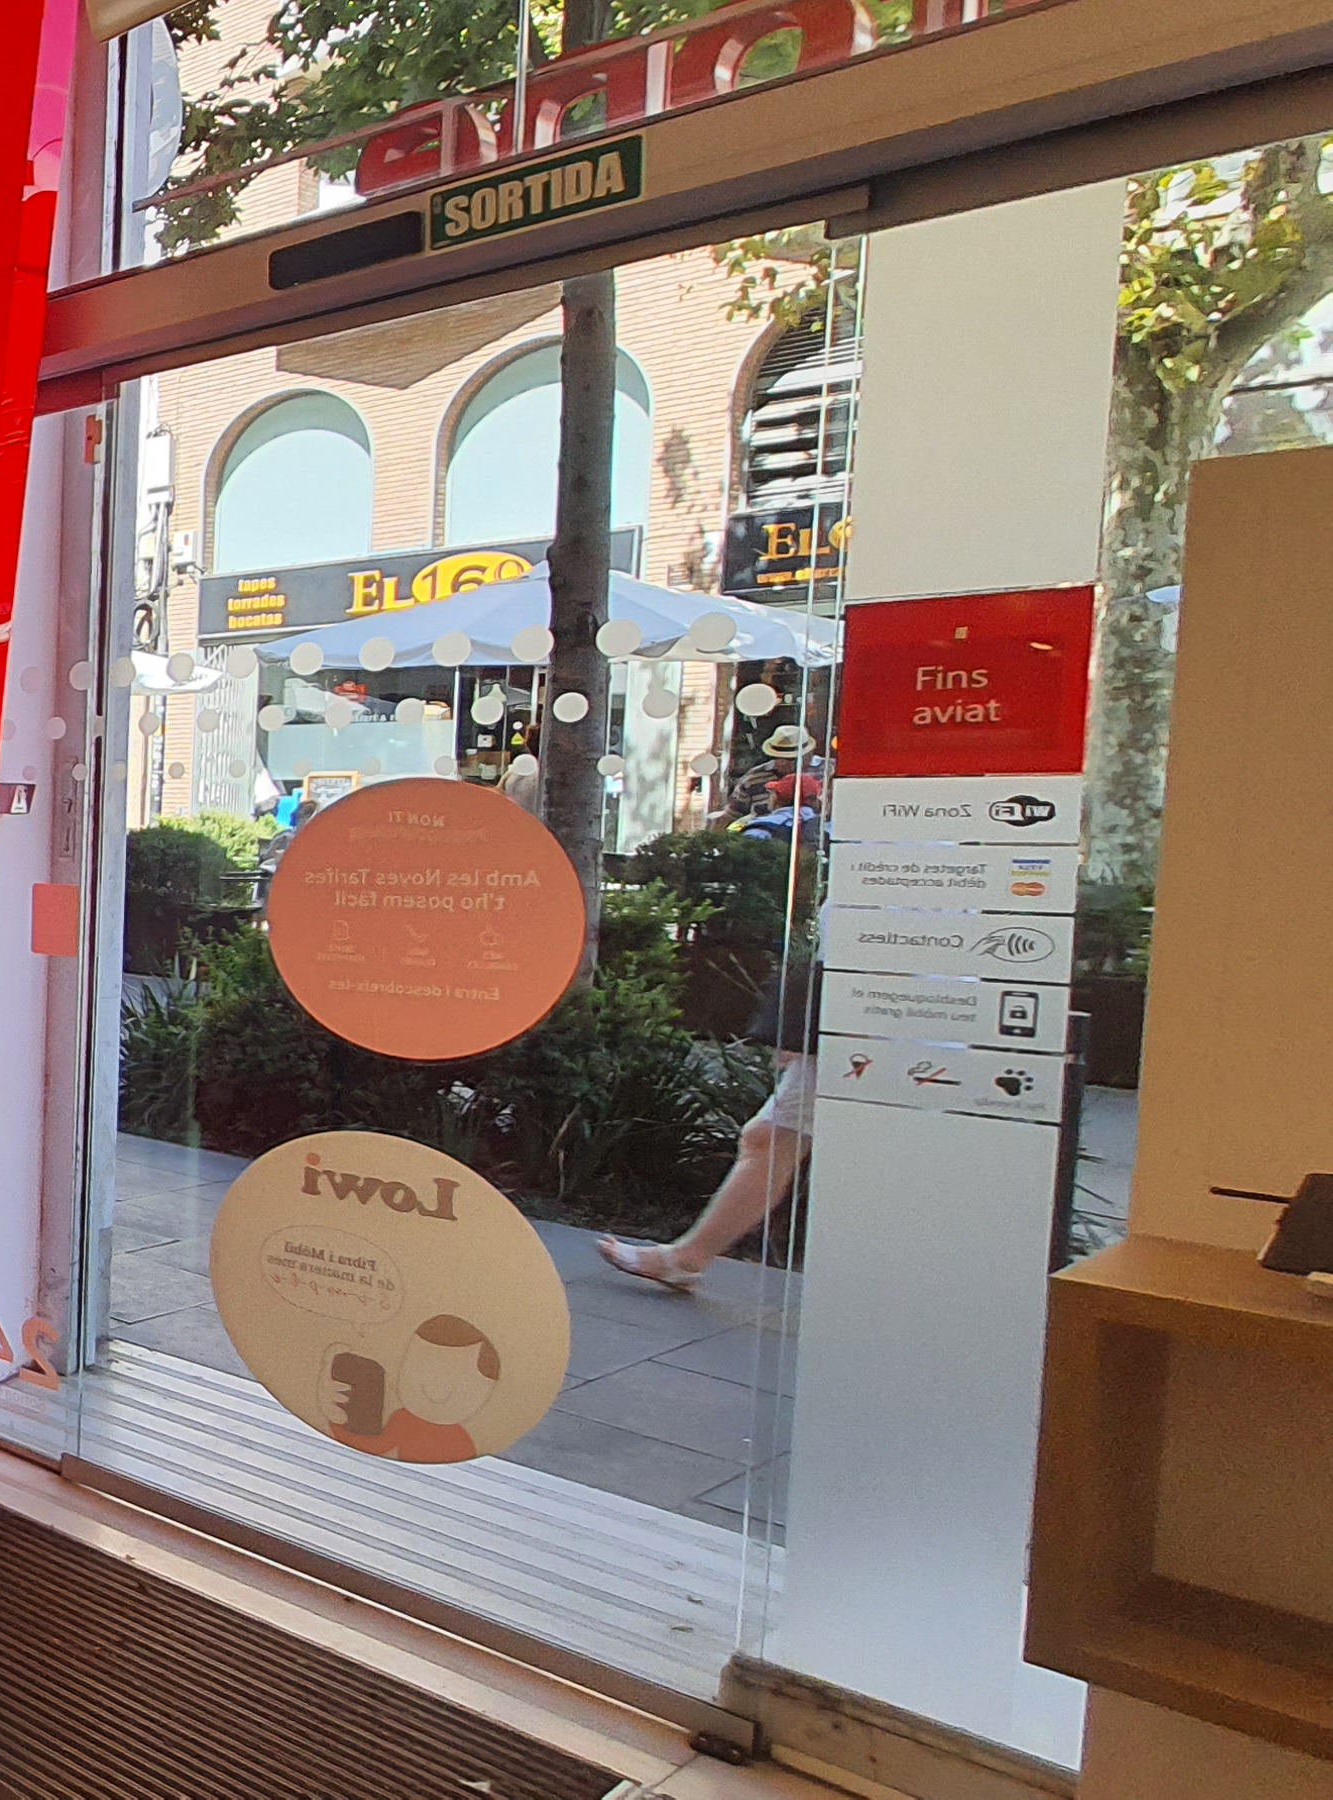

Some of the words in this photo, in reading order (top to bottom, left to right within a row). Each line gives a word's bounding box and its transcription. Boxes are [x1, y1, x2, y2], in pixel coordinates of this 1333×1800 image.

[445, 151, 626, 237] SORTIDA
[238, 576, 277, 594] tapes
[915, 664, 989, 691] Fins
[912, 699, 1002, 726] aviat
